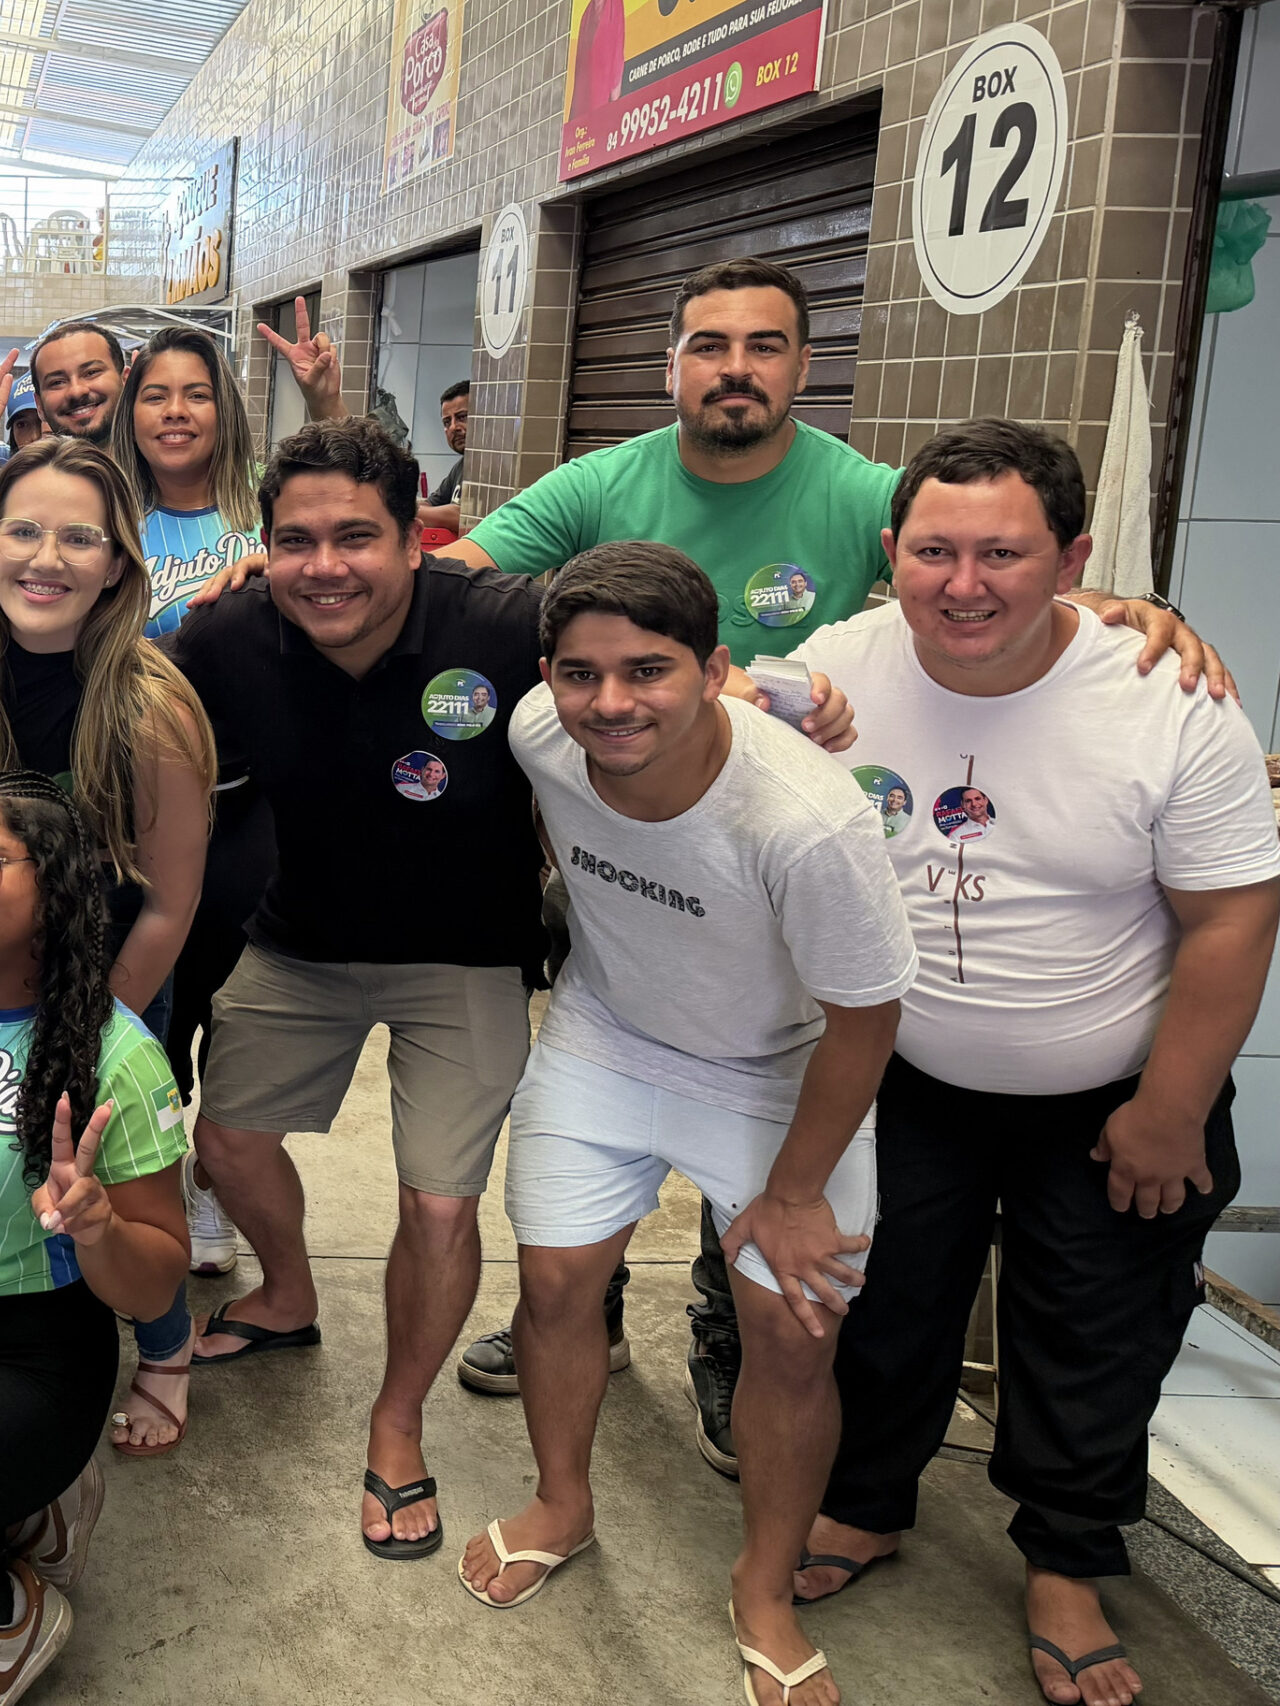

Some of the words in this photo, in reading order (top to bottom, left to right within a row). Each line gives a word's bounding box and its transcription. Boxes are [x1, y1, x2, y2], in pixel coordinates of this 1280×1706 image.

[628, 61, 649, 83] CARNE
[648, 58, 658, 74] DE
[657, 48, 681, 71] PORCO,
[682, 39, 702, 58] BODE
[701, 37, 707, 49] E
[707, 26, 728, 46] TUDO
[728, 16, 749, 36] PARA
[749, 5, 766, 26] SUA
[404, 46, 442, 95] Porco
[755, 56, 782, 87] BOX
[784, 52, 800, 76] 12
[972, 65, 1018, 103] BOX
[606, 130, 618, 152] 84
[620, 71, 724, 147] 99952-4211
[940, 102, 1038, 237] 12
[500, 226, 515, 243] BOX
[491, 244, 520, 316] 11
[750, 591, 790, 607] 22111
[427, 700, 469, 715] 22111
[938, 811, 968, 823] MOTTA
